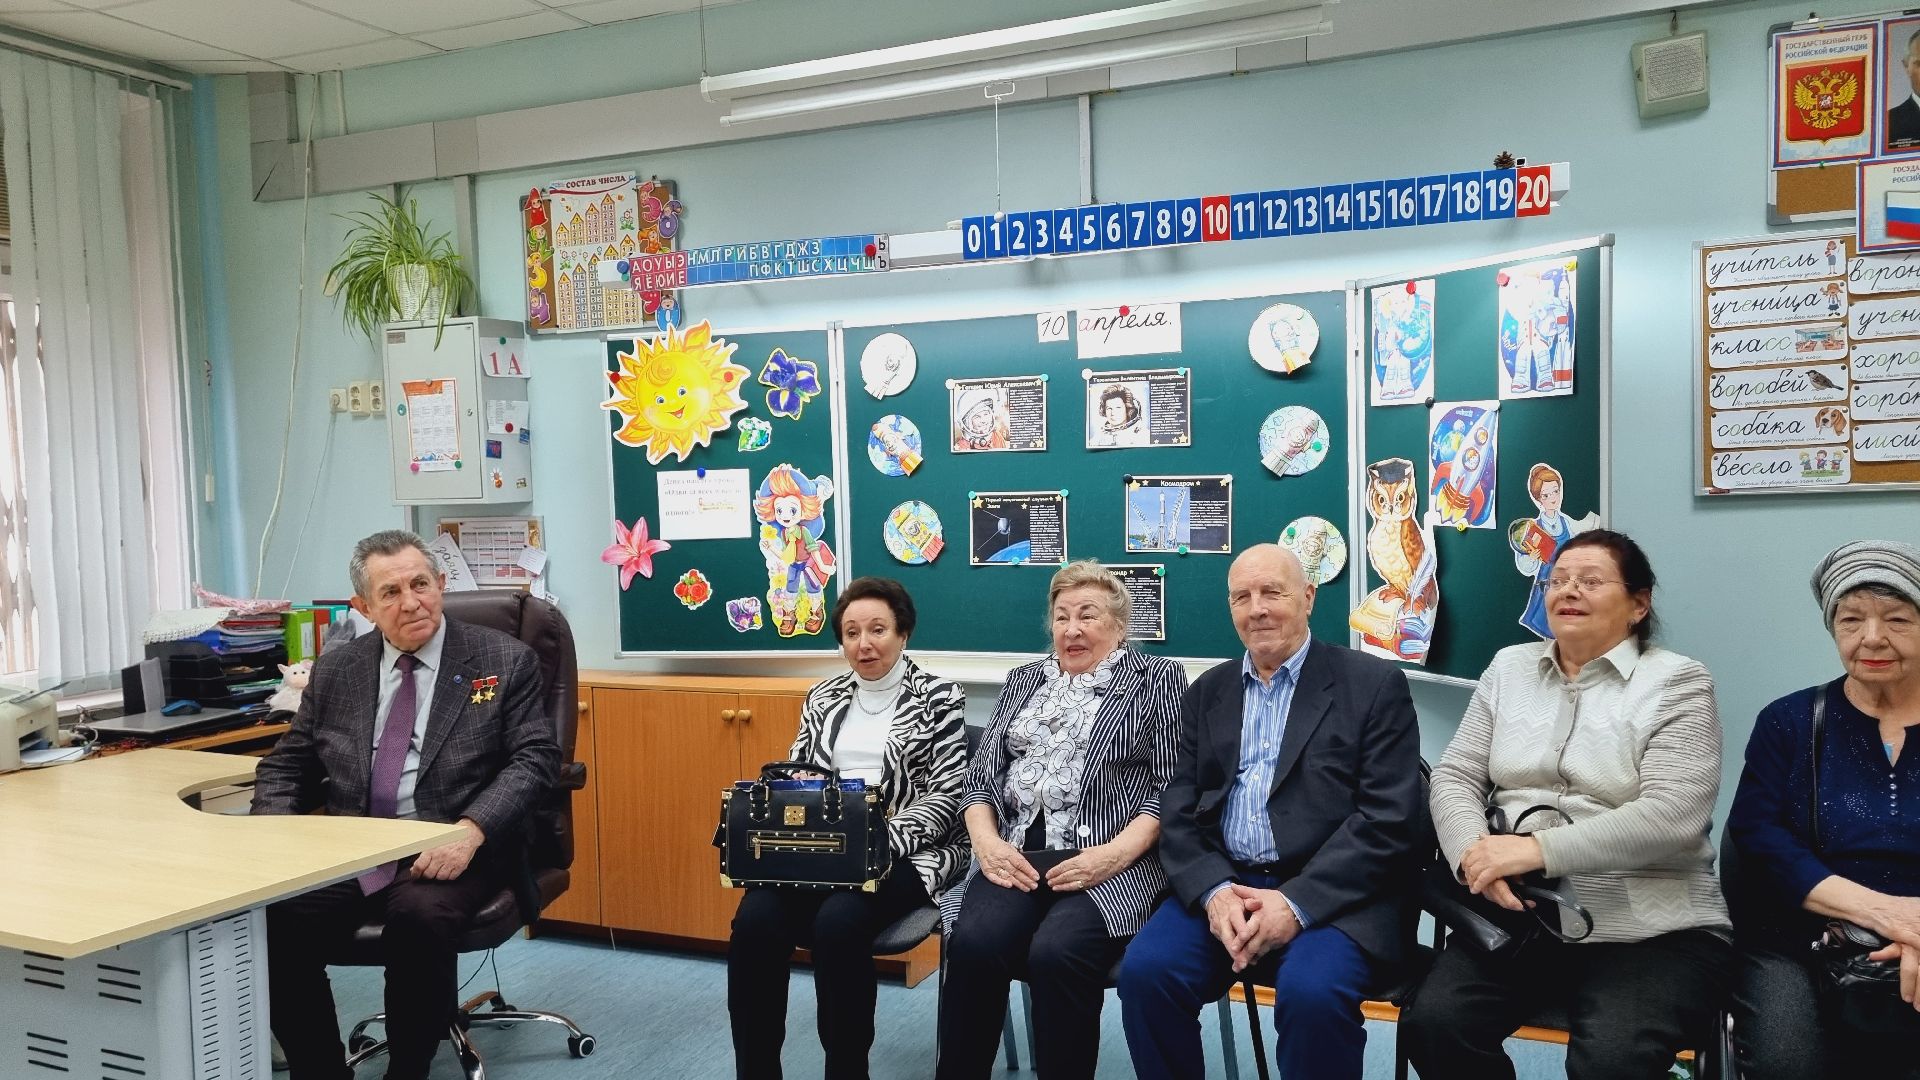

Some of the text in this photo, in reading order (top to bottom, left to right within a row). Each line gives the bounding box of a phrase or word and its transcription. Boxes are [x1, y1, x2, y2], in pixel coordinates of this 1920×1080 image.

[1785, 43, 1868, 59] РОССИЙСКОЙ ФЕДЕРАЦИИ
[566, 179, 596, 188] СОСТАВ
[598, 175, 627, 185] ЧИСЛА
[967, 174, 1549, 252] 0 1 2 3 4 5 6 7 8 9 10 11 12 13 14 15 16 17 18 19 20
[1041, 315, 1066, 336] 10
[1711, 336, 1792, 356] класс
[1160, 479, 1195, 487] Космодром
